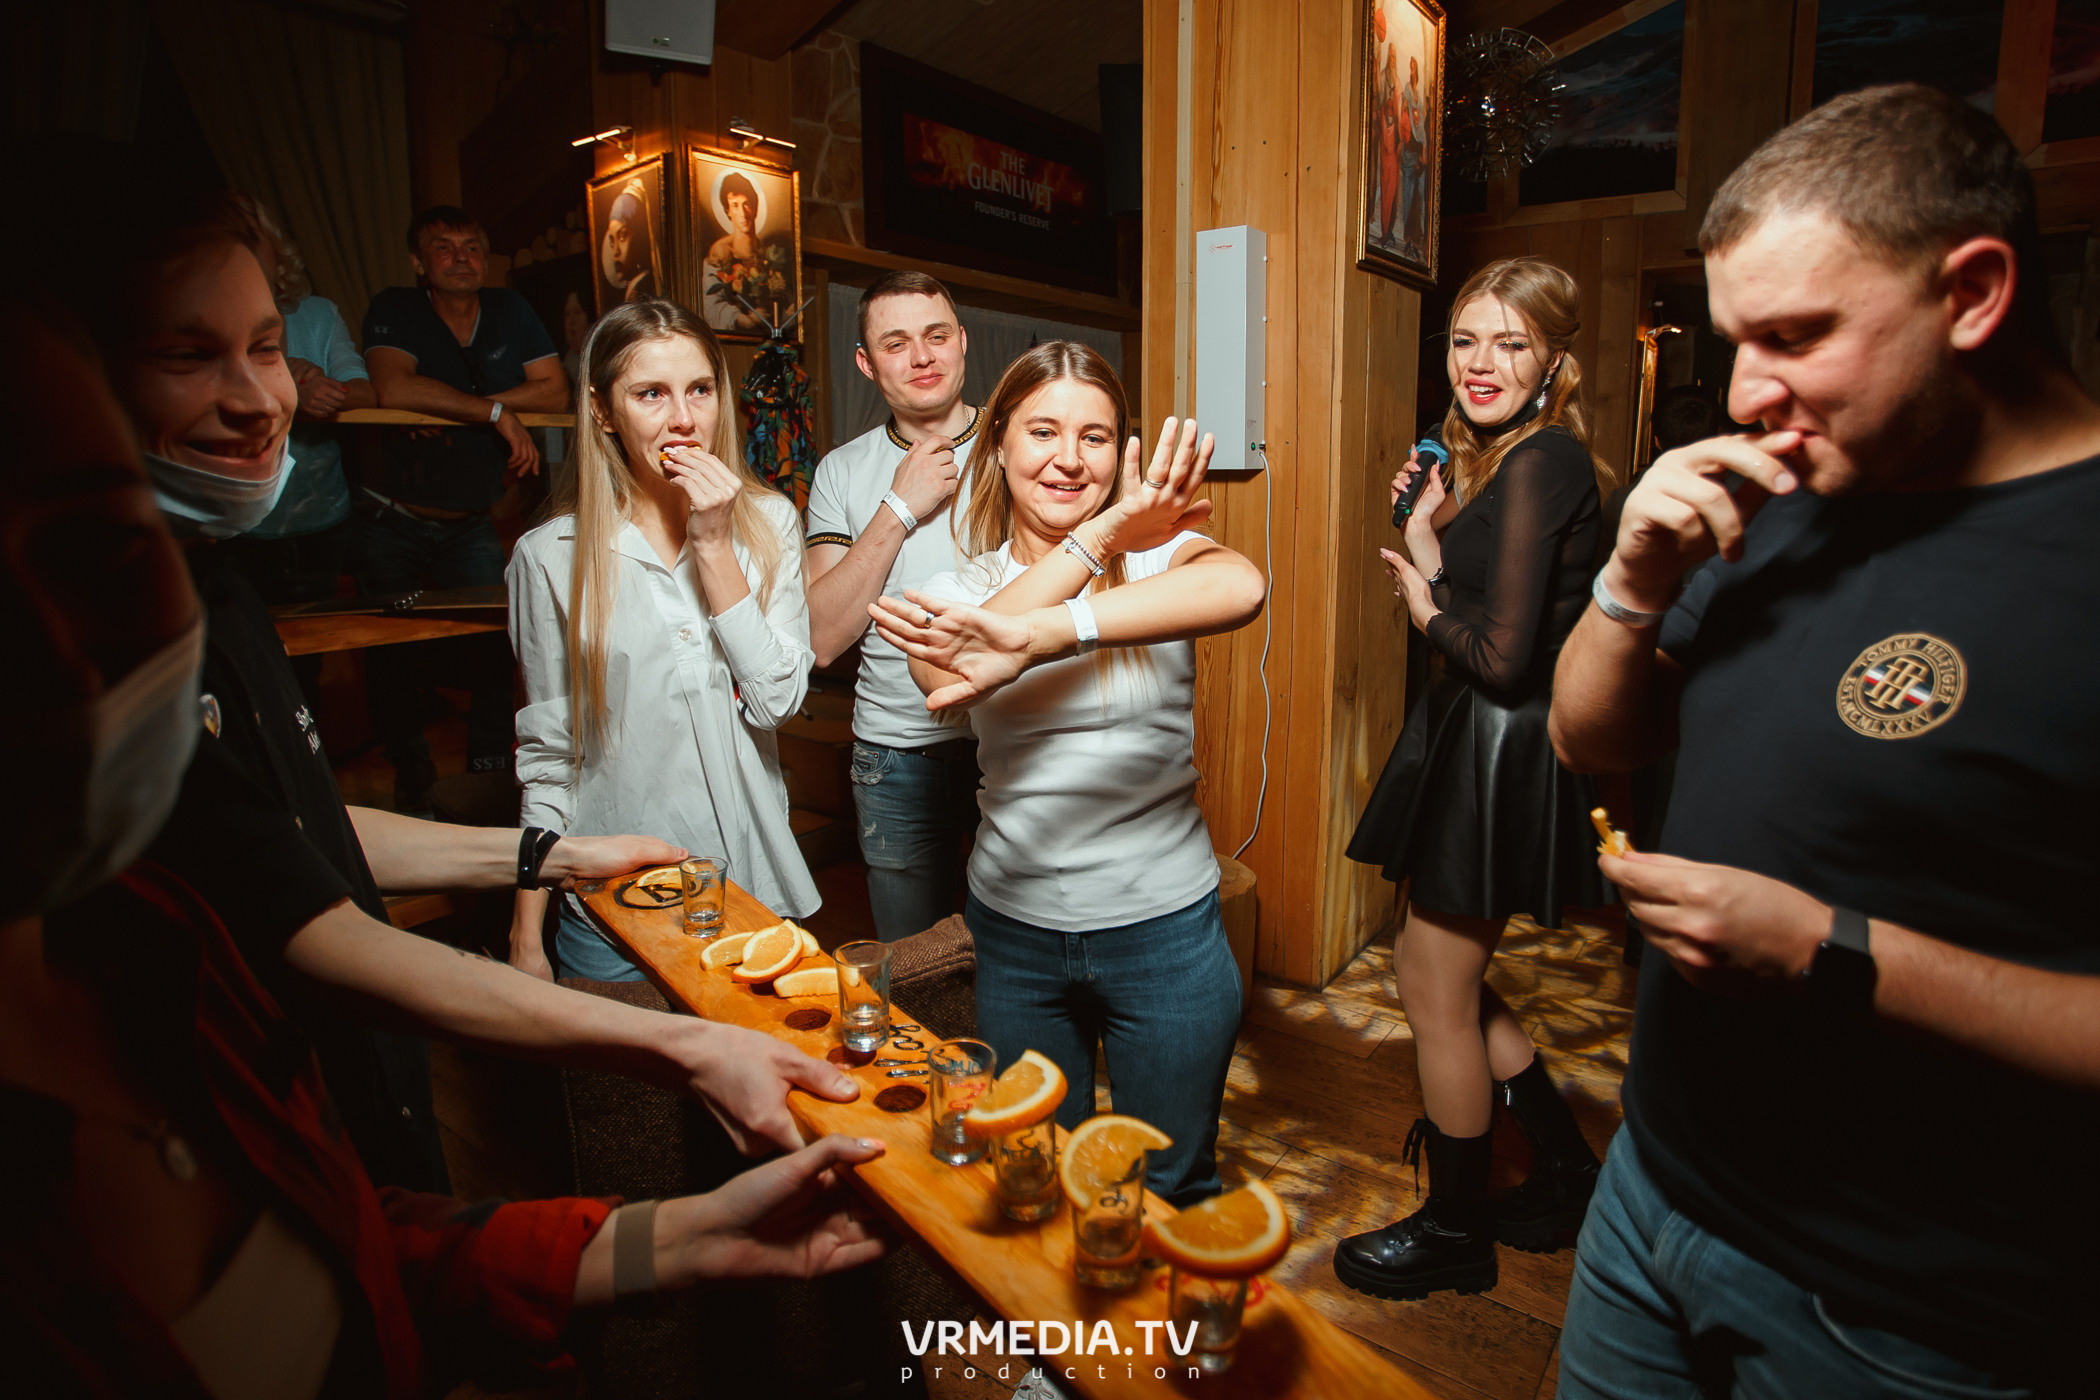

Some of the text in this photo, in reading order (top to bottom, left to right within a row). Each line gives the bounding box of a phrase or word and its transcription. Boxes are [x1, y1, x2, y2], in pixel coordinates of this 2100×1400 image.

[1000, 151, 1027, 176] THE
[966, 162, 1055, 212] GLENLIVET
[974, 200, 1052, 231] FOUNDER'S RESERVE
[1860, 638, 1957, 705] TOMMY HILFIGER
